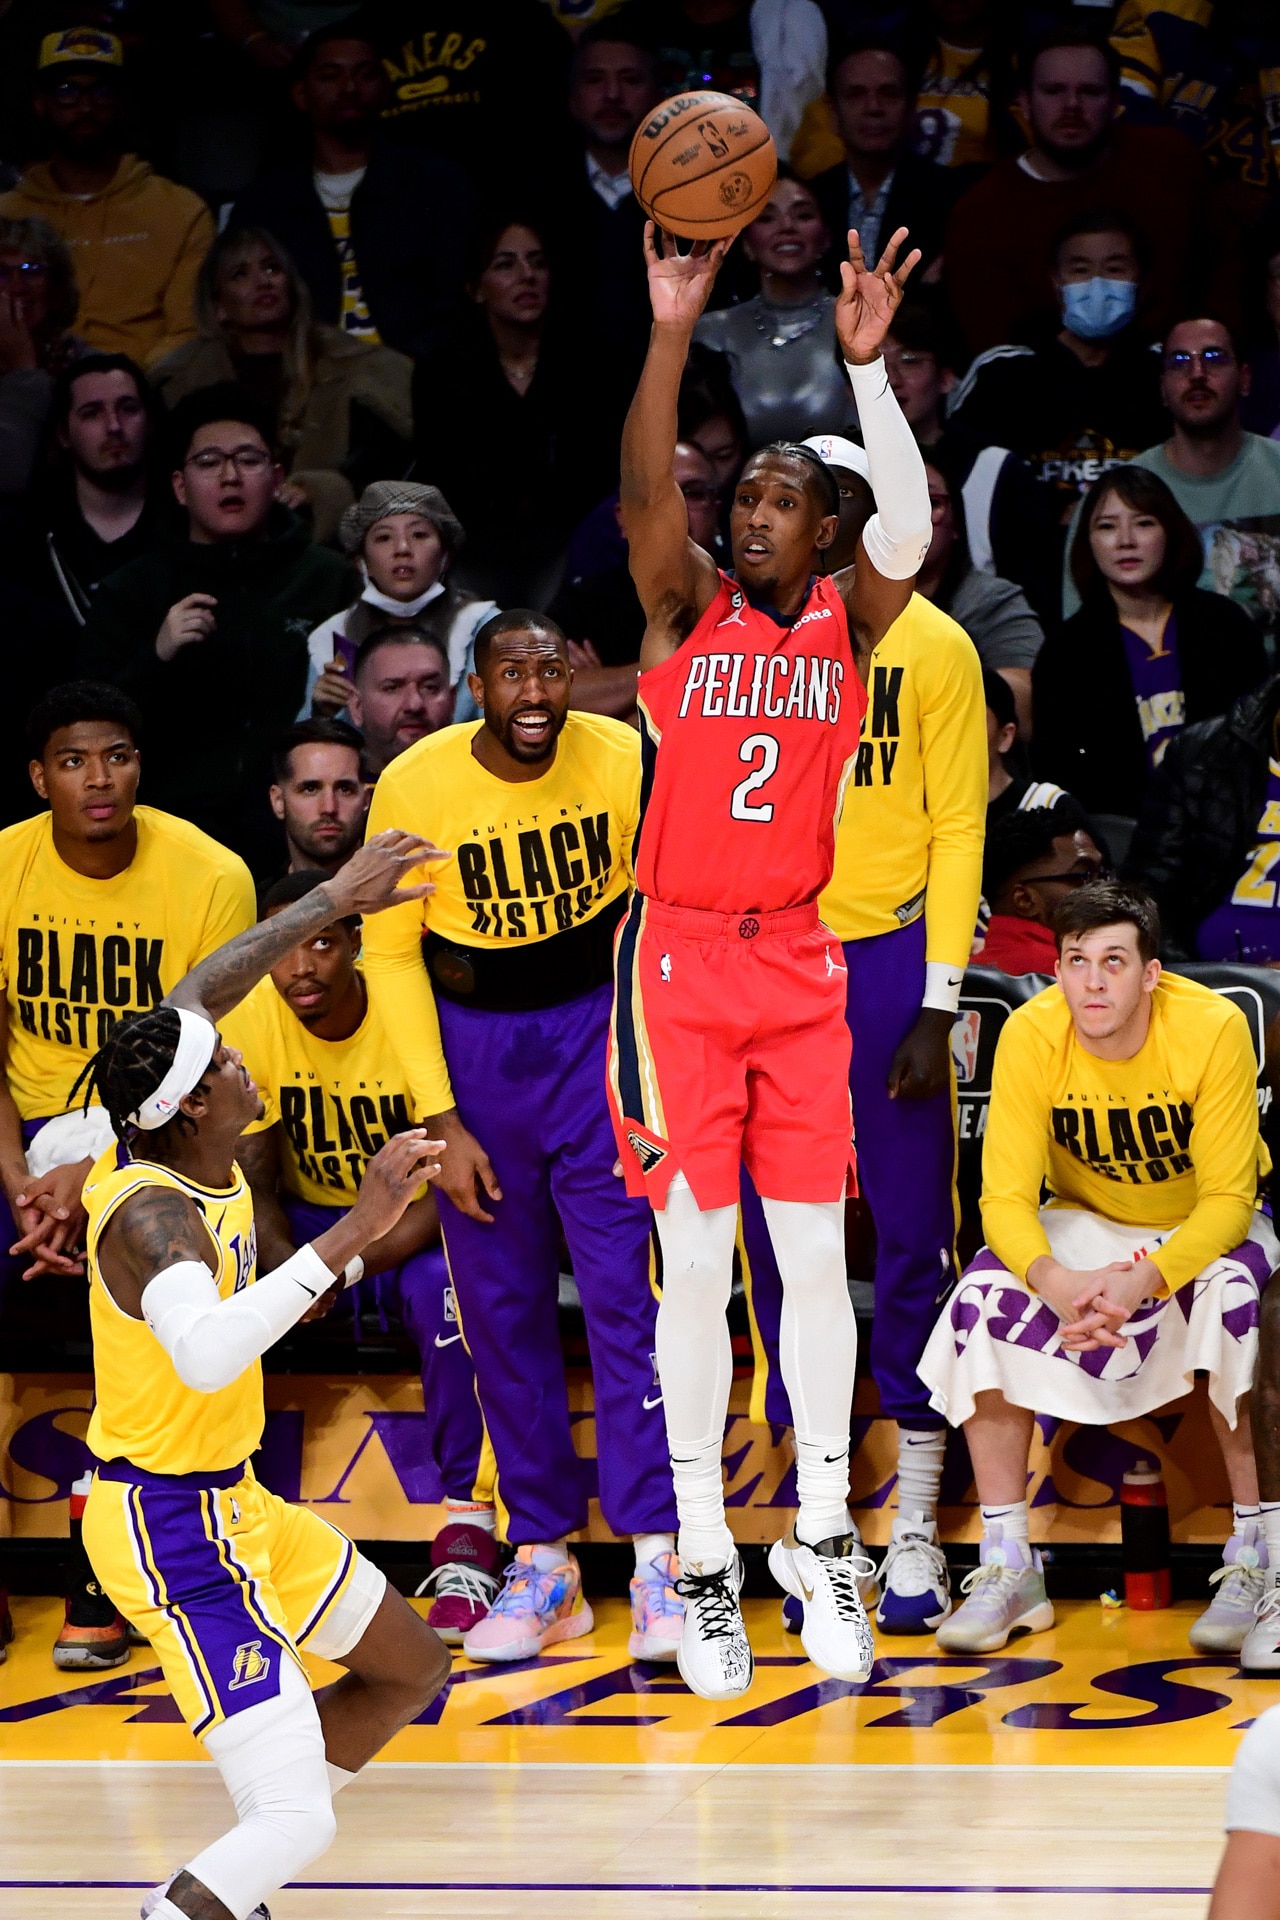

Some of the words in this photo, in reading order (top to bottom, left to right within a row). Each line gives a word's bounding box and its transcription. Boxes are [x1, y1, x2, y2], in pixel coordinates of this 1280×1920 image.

[678, 653, 844, 725] PELICANS
[730, 732, 781, 824] 2
[472, 815, 539, 837] BUILT
[560, 804, 583, 817] BY
[457, 811, 612, 900] BLACK
[33, 914, 96, 927] BUILT
[117, 922, 141, 930] BY
[17, 928, 164, 1008] BLACK
[18, 998, 134, 1049] HISTO
[294, 1071, 341, 1089] BUT
[359, 1081, 383, 1089] BY
[1147, 1090, 1169, 1100] BY
[447, 1546, 478, 1556] adidas
